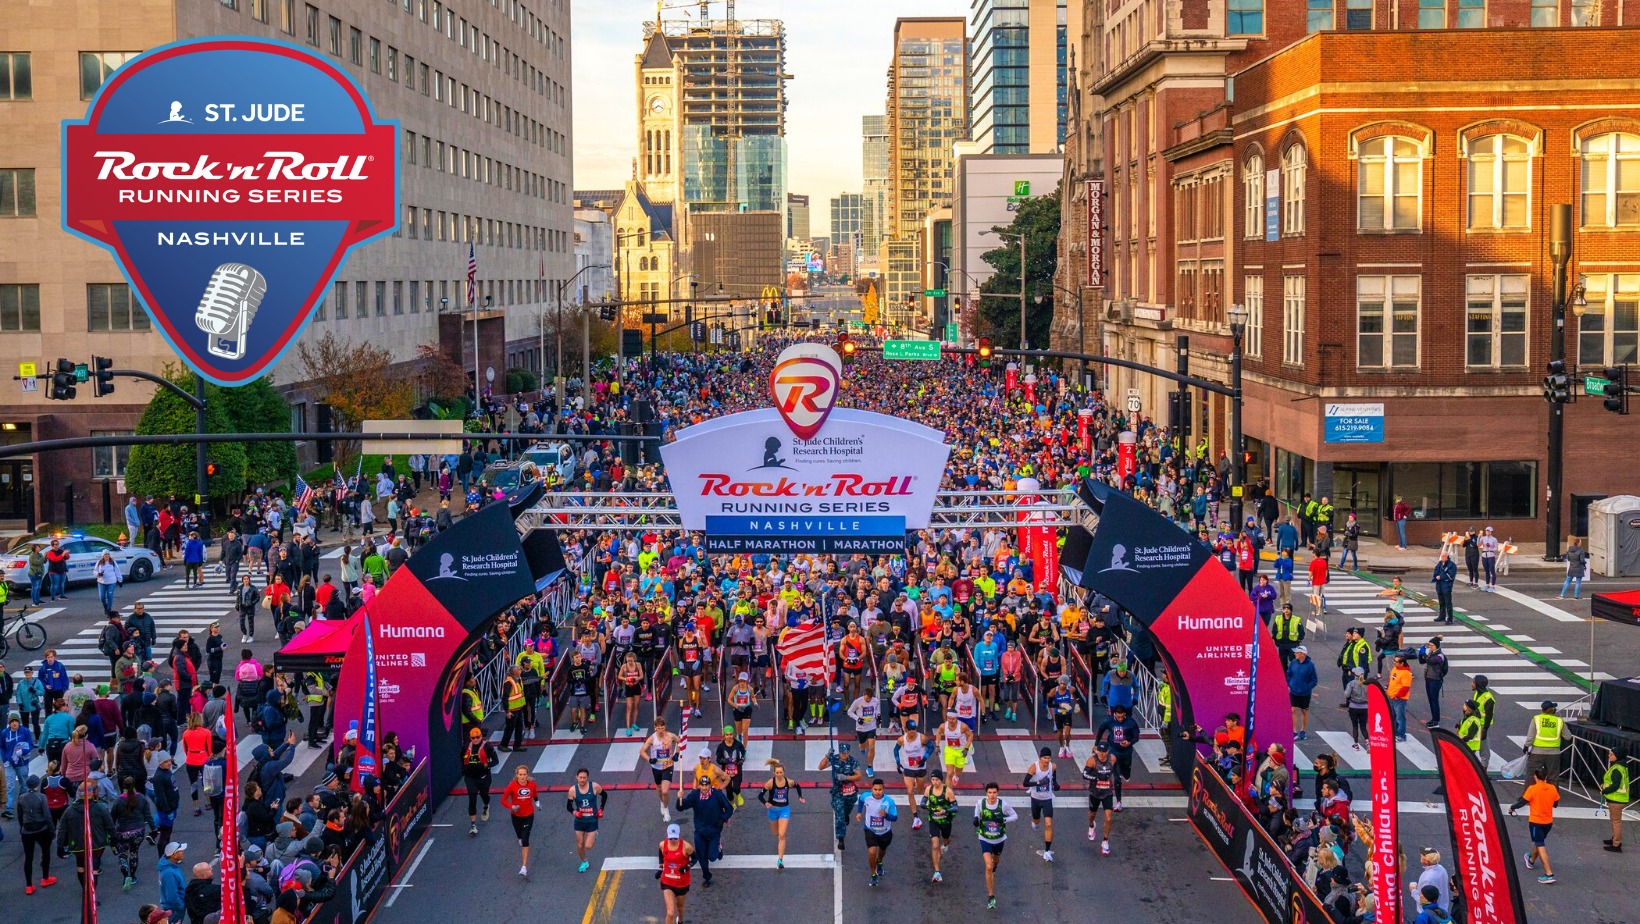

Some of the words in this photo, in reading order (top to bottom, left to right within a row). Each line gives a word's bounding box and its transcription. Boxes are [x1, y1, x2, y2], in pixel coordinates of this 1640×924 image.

[1090, 182, 1101, 230] MORGAN
[1091, 230, 1100, 238] &
[1090, 238, 1101, 286] MORGAN
[928, 343, 934, 351] S
[1129, 400, 1140, 409] 70
[804, 437, 822, 448] Jude
[823, 437, 864, 446] Children's
[793, 446, 828, 455] Research
[829, 446, 863, 457] Hospital
[1126, 446, 1132, 454] 2
[698, 473, 800, 497] Rock
[721, 502, 813, 513] RUNNING
[818, 501, 891, 513] SERIES
[749, 520, 861, 531] NASHVILLE
[709, 540, 742, 550] HALF
[745, 540, 816, 550] MARATHON
[833, 540, 904, 550] MARATHON
[1143, 546, 1158, 555] Jude
[1158, 545, 1191, 553] Children's
[471, 554, 485, 564] Jude
[485, 552, 518, 562] Children's
[1134, 554, 1164, 562] Research
[1163, 552, 1191, 561] Hospital
[462, 562, 491, 570] Research
[491, 560, 518, 569] Hospital
[1177, 615, 1243, 630] Humana
[379, 624, 445, 638] Humana
[581, 798, 590, 807] B
[1467, 791, 1497, 889] Rock
[1459, 808, 1480, 900] RUNNING
